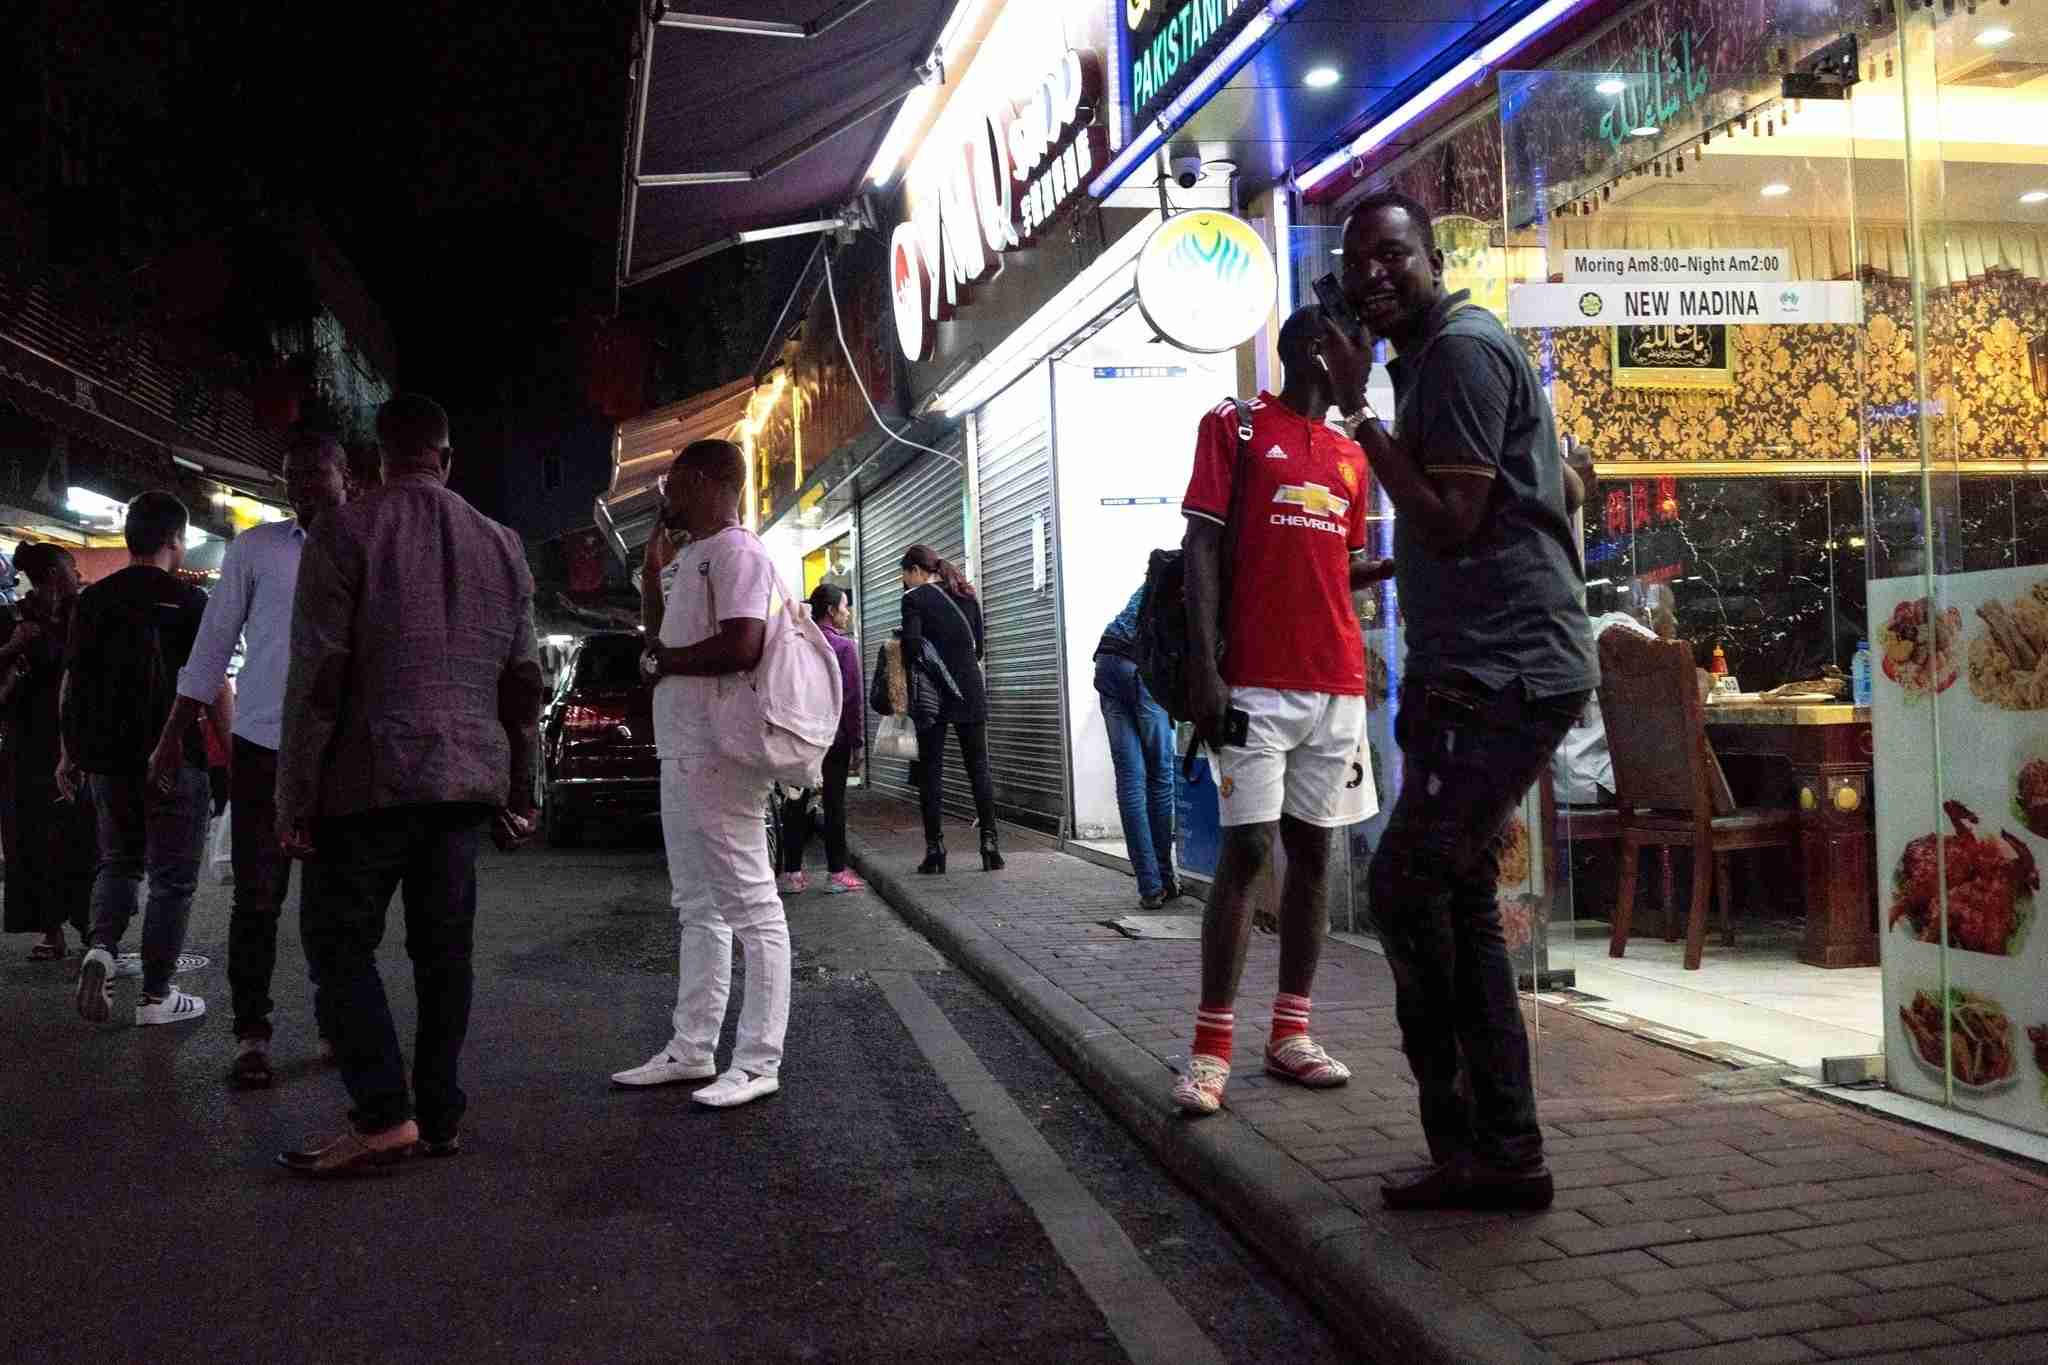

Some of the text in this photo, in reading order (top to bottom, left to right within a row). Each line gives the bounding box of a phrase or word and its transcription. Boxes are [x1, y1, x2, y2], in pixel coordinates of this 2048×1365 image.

[1575, 256, 1624, 276] Moring
[1729, 256, 1779, 272] Am2:00
[1625, 290, 1759, 316] NEW MADINA
